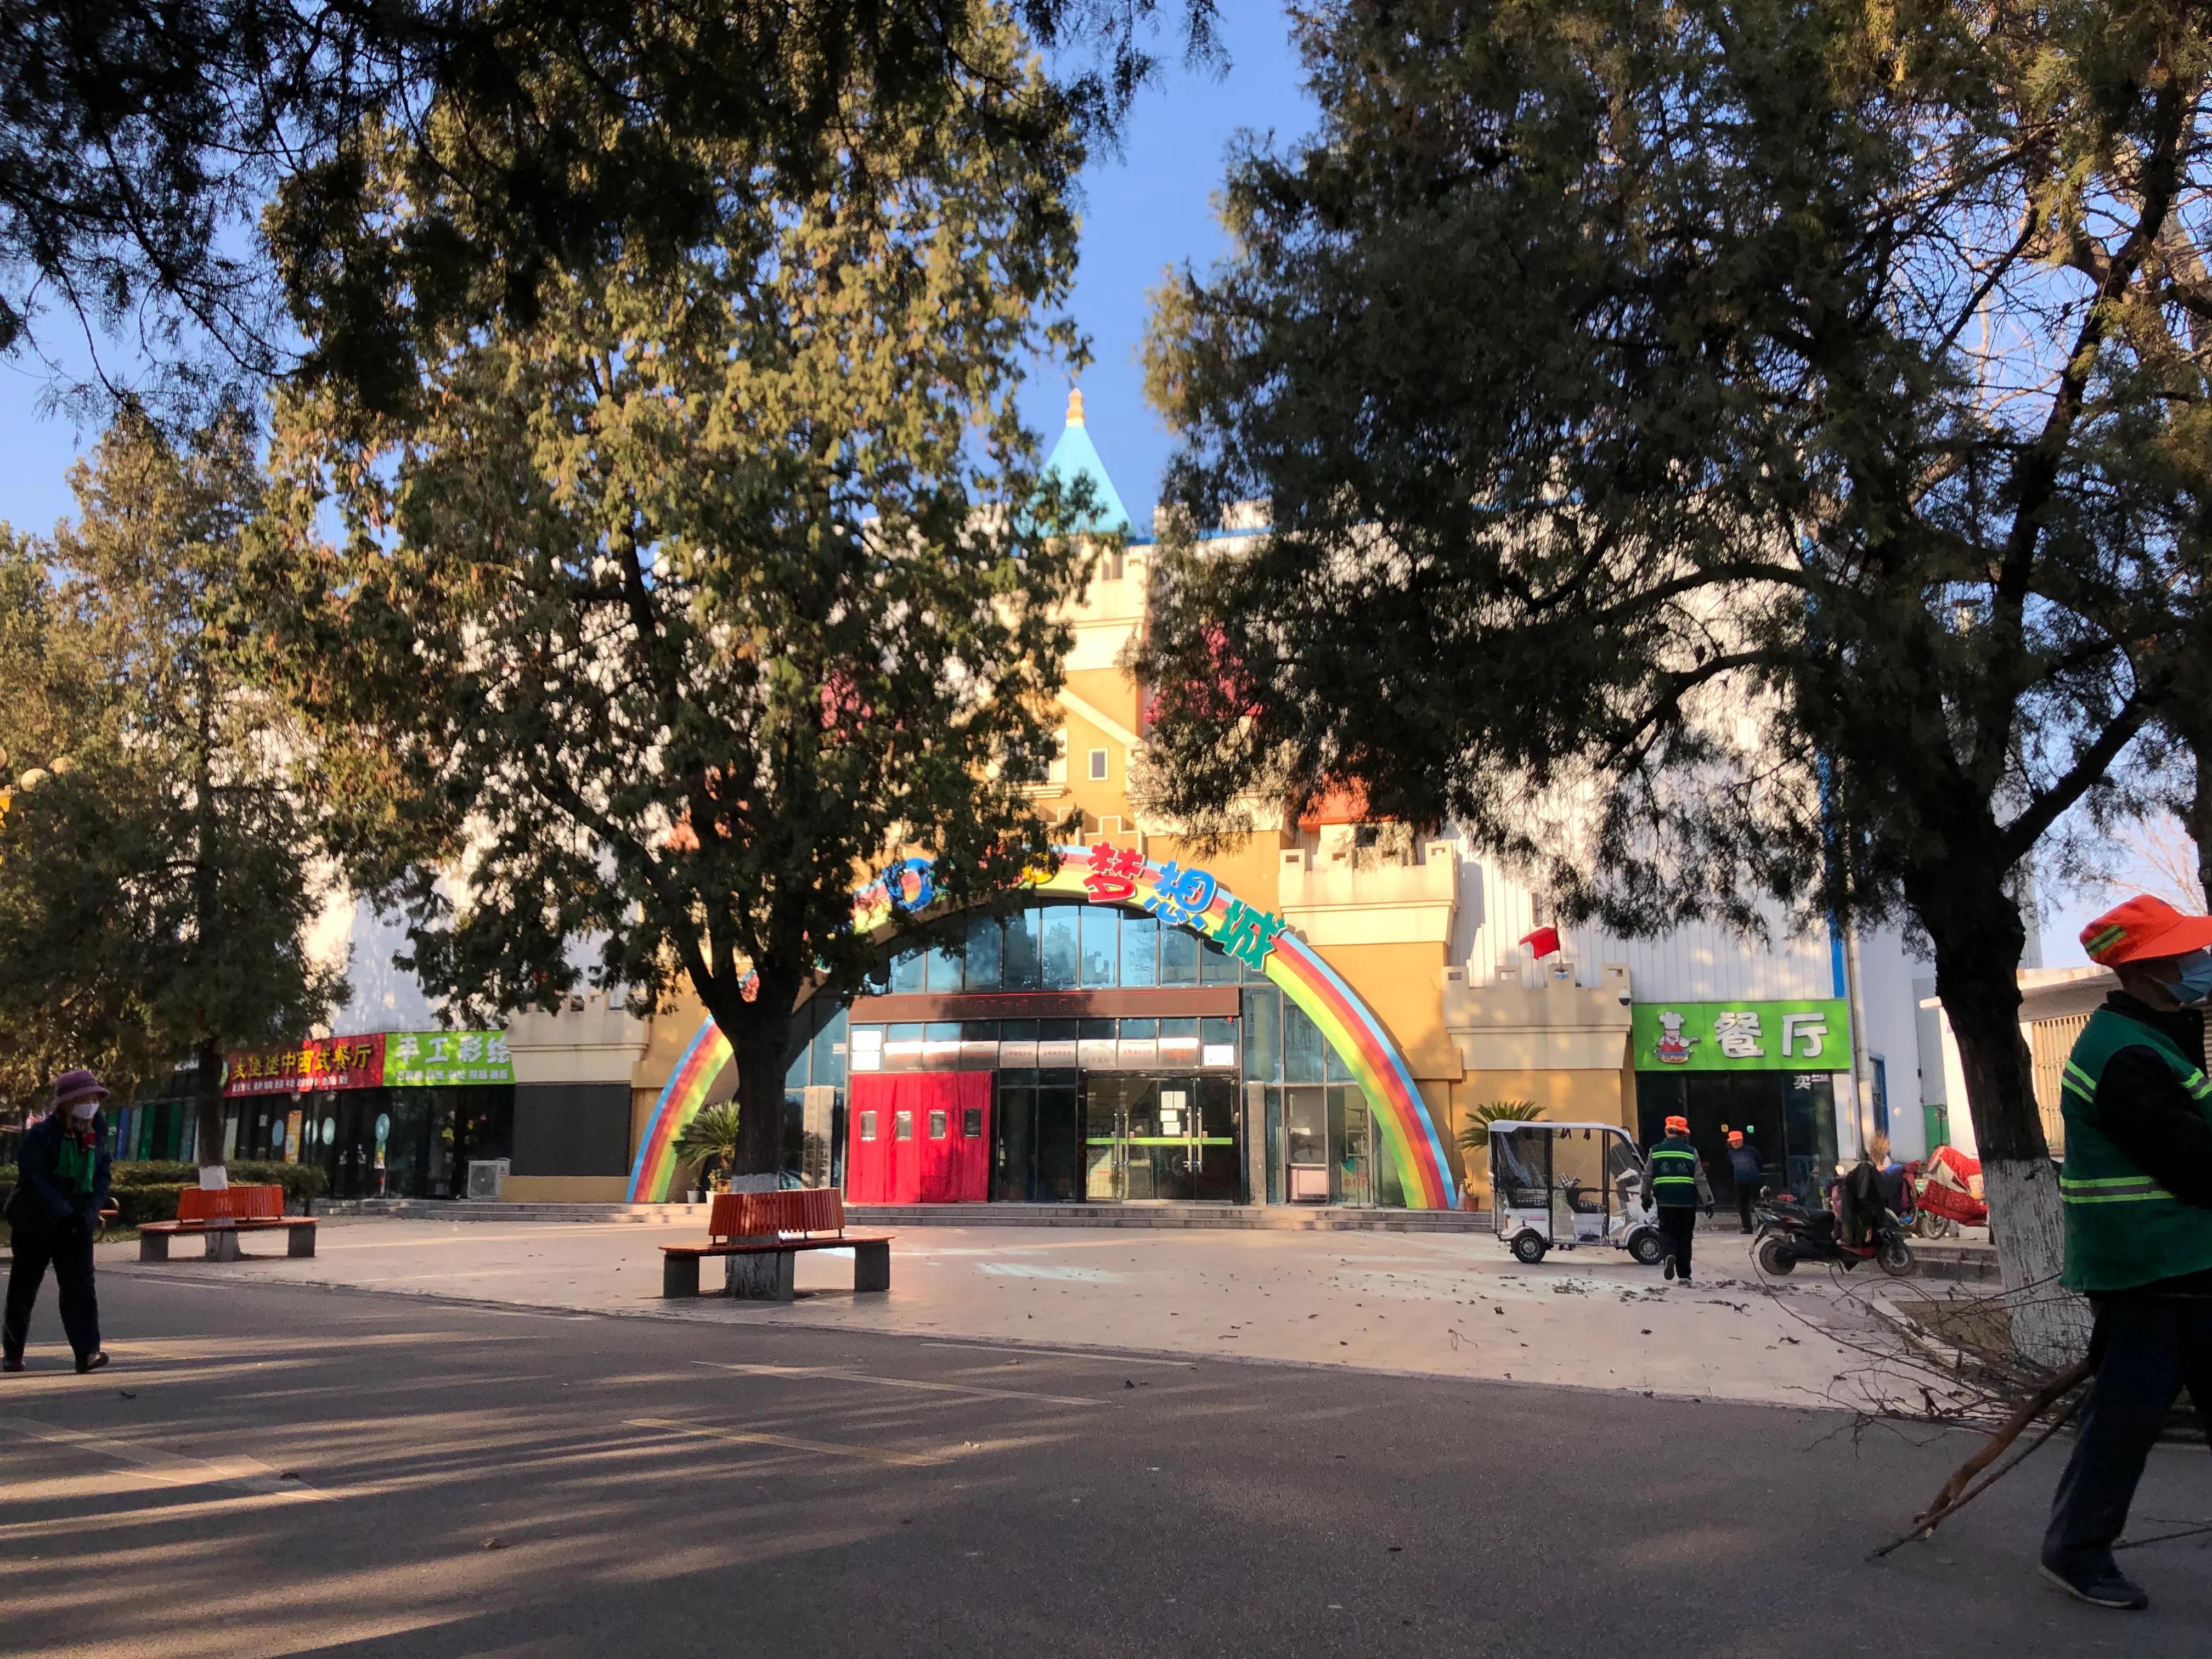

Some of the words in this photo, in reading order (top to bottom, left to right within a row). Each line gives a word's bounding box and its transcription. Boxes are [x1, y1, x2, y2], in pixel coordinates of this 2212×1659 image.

[1083, 840, 1285, 970] 梦想城
[395, 1035, 511, 1064] 手工彩绘
[1713, 1011, 1827, 1058] 餐厅
